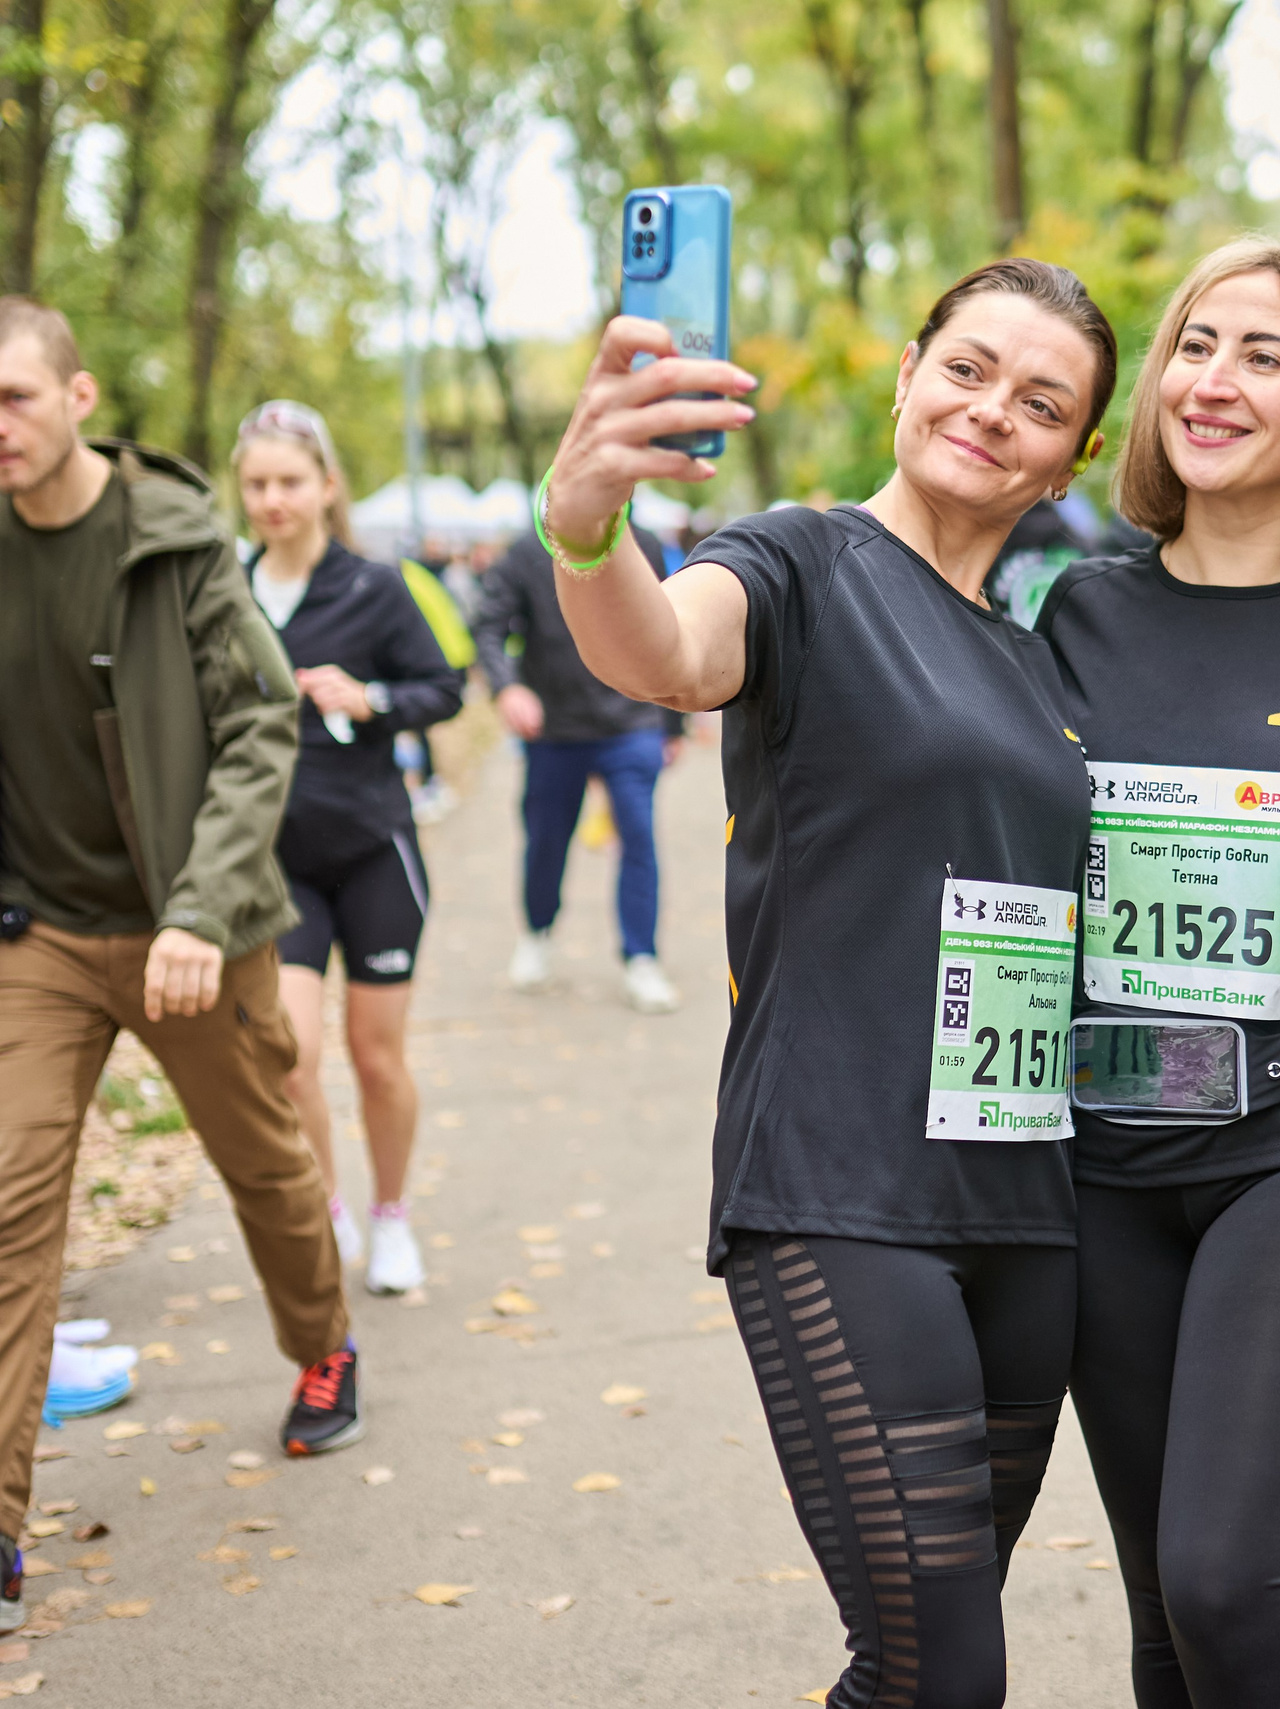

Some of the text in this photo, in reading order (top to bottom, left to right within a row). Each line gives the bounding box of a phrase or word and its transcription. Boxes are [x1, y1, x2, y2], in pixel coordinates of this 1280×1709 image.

[1125, 780, 1184, 793] UNDER
[1124, 792, 1198, 804] ARMOUR
[1090, 817, 1104, 825] ЕНЬ
[1104, 818, 1124, 826] 963:
[1125, 818, 1178, 828] КИЇВСЬКИЙ
[1180, 822, 1229, 832] МАРАФОН
[1130, 841, 1269, 864] Смарт Простір GoRun
[1172, 868, 1218, 885] Тетяна
[995, 900, 1038, 915] UNDER
[994, 912, 1047, 928] ARMOUR
[1086, 924, 1106, 936] 02:19
[1112, 899, 1275, 966] 21525
[945, 938, 972, 946] ДЕНЬ
[973, 939, 992, 948] 963:
[994, 940, 1035, 952] КИЇВСЬКИЙ
[1036, 945, 1062, 954] МАРАФОН
[997, 966, 1028, 984] Смарт
[1030, 968, 1058, 987] Простір
[1144, 980, 1266, 1007] ПриватБанк
[1028, 994, 1056, 1010] Альона
[940, 1055, 965, 1066] 01:59
[971, 1026, 1069, 1088] 21511
[1000, 1107, 1062, 1132] ПриватБанк
